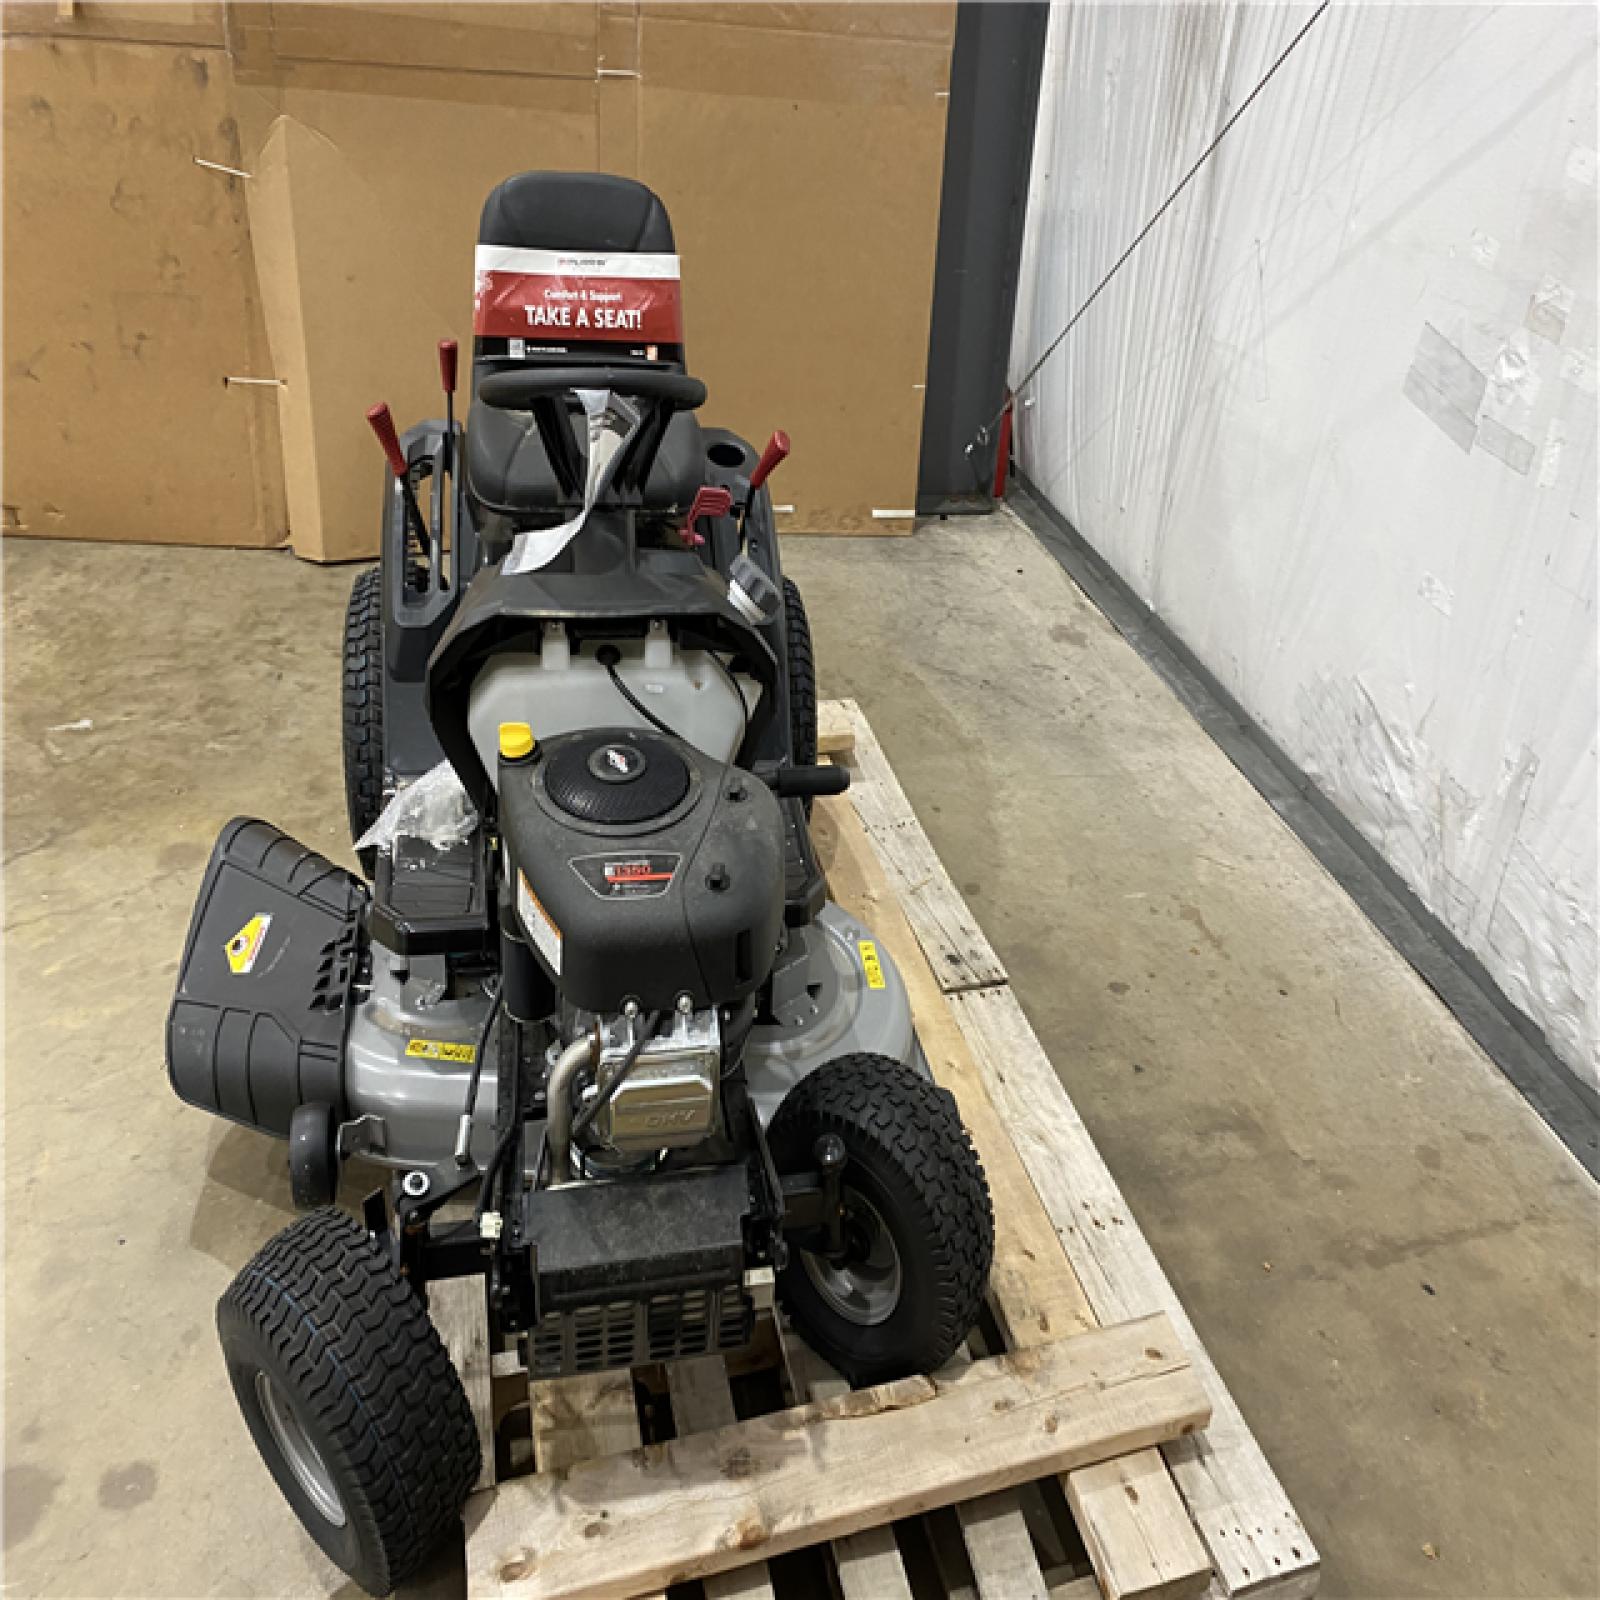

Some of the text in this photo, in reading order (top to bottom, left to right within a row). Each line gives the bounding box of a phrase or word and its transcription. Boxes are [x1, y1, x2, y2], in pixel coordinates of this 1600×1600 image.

[544, 289, 579, 301] Comfort
[589, 289, 622, 302] Support
[525, 304, 642, 329] TAKE A SEAT!
